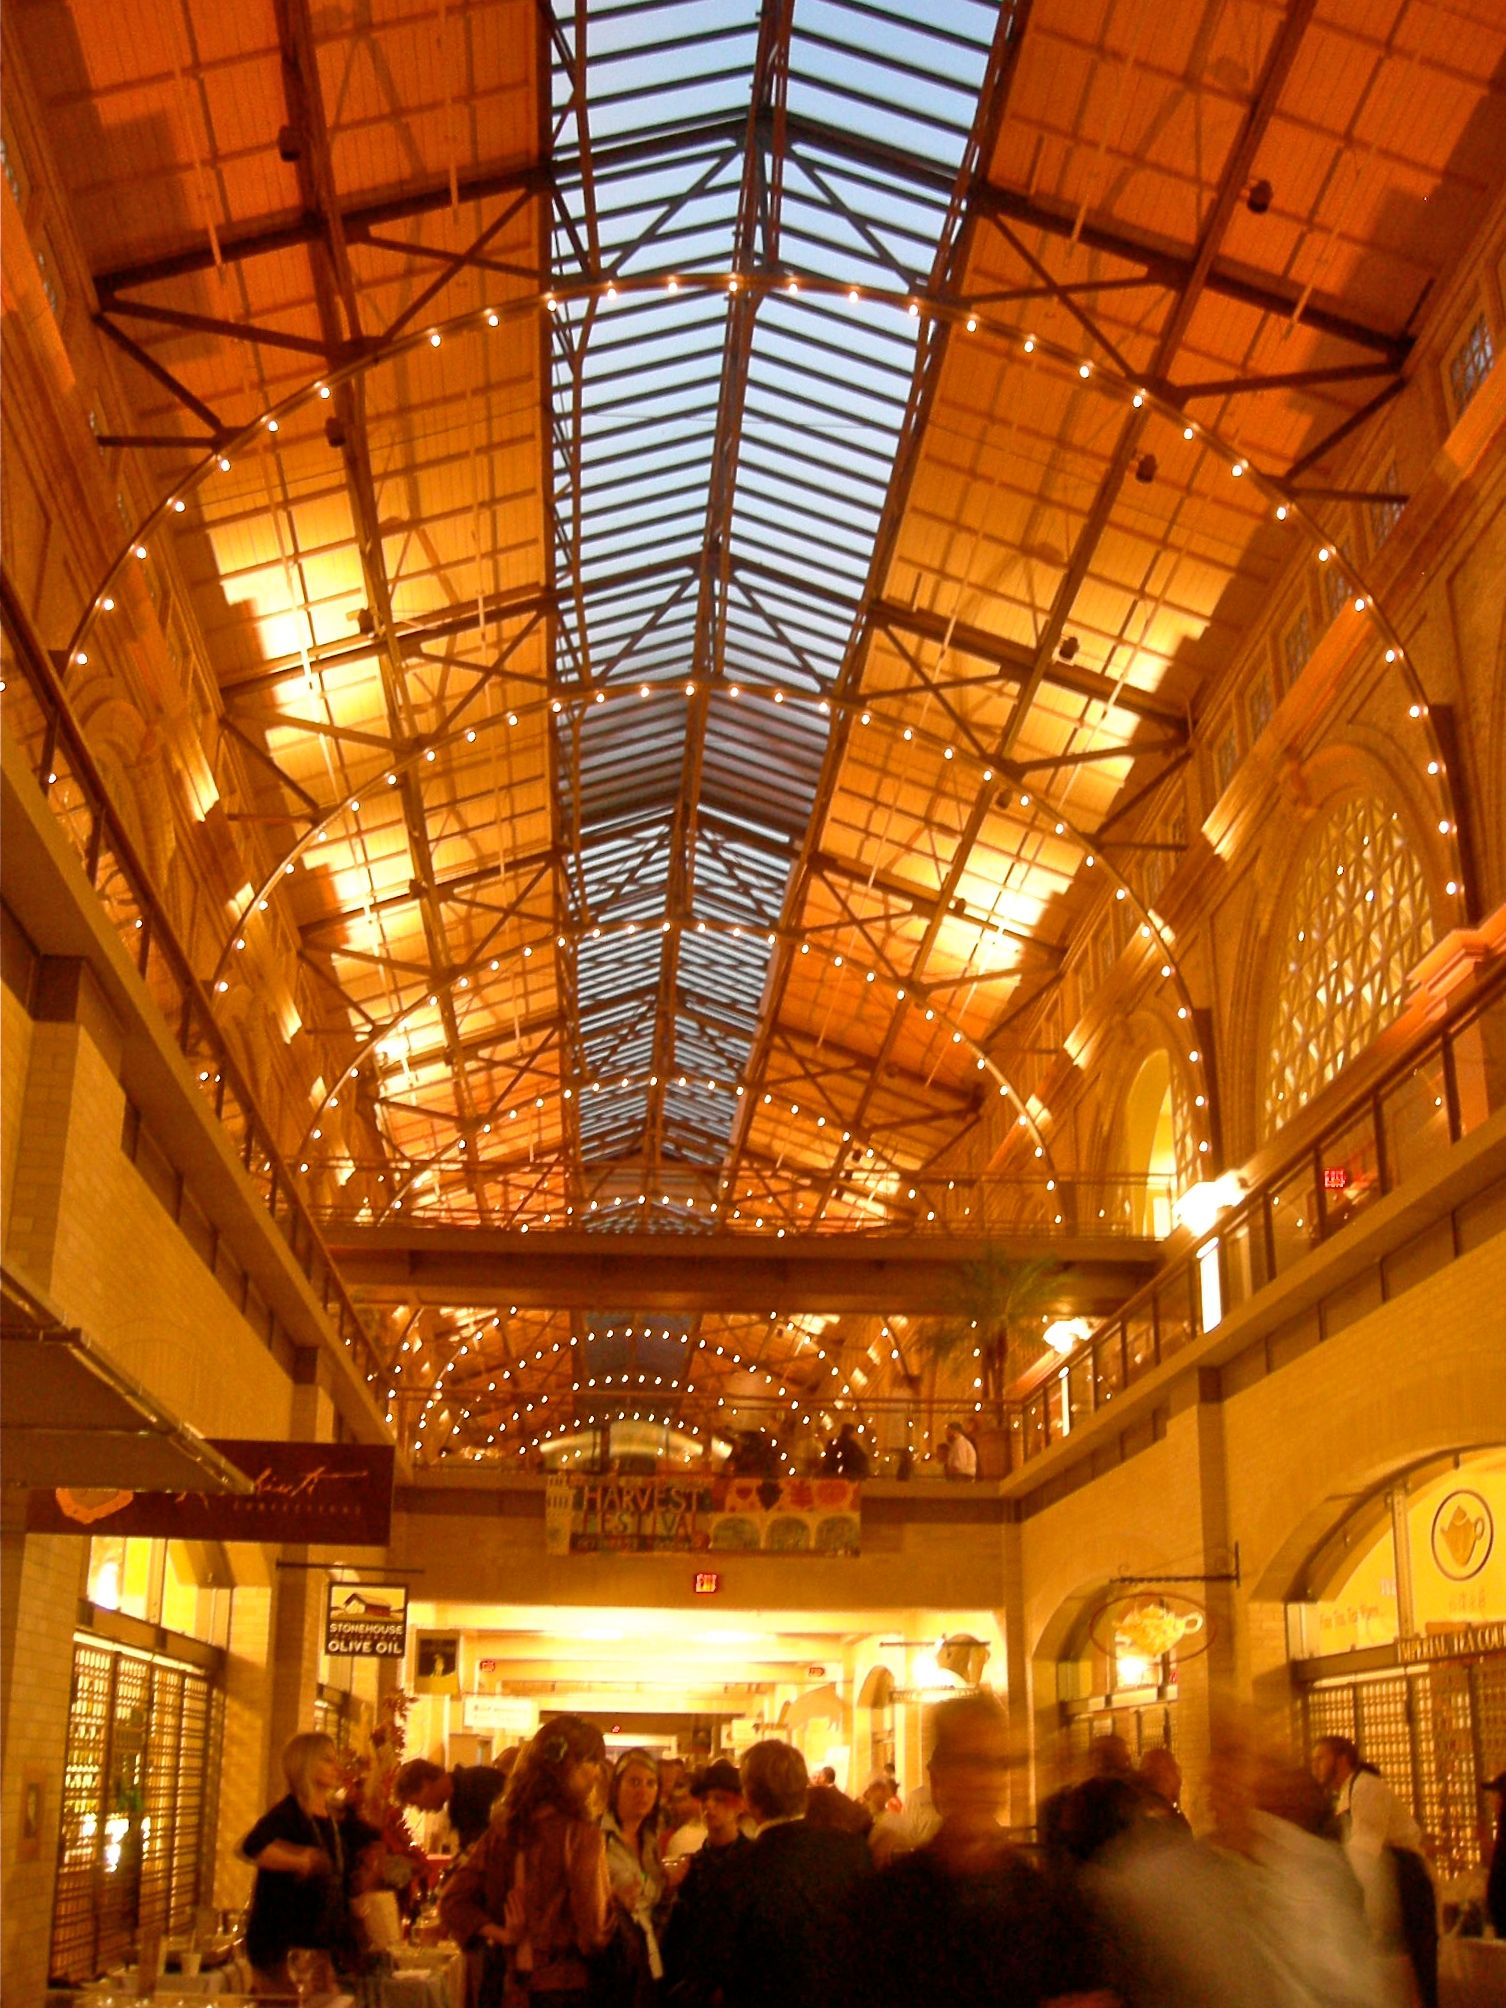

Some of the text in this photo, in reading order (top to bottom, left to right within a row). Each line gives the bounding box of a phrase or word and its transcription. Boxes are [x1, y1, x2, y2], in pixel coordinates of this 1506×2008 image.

[583, 1485, 699, 1512] HARVEST
[582, 1510, 697, 1535] FESTIVAL
[329, 1623, 403, 1635] STONEHOUSE
[328, 1640, 402, 1654] OLIVE OIL
